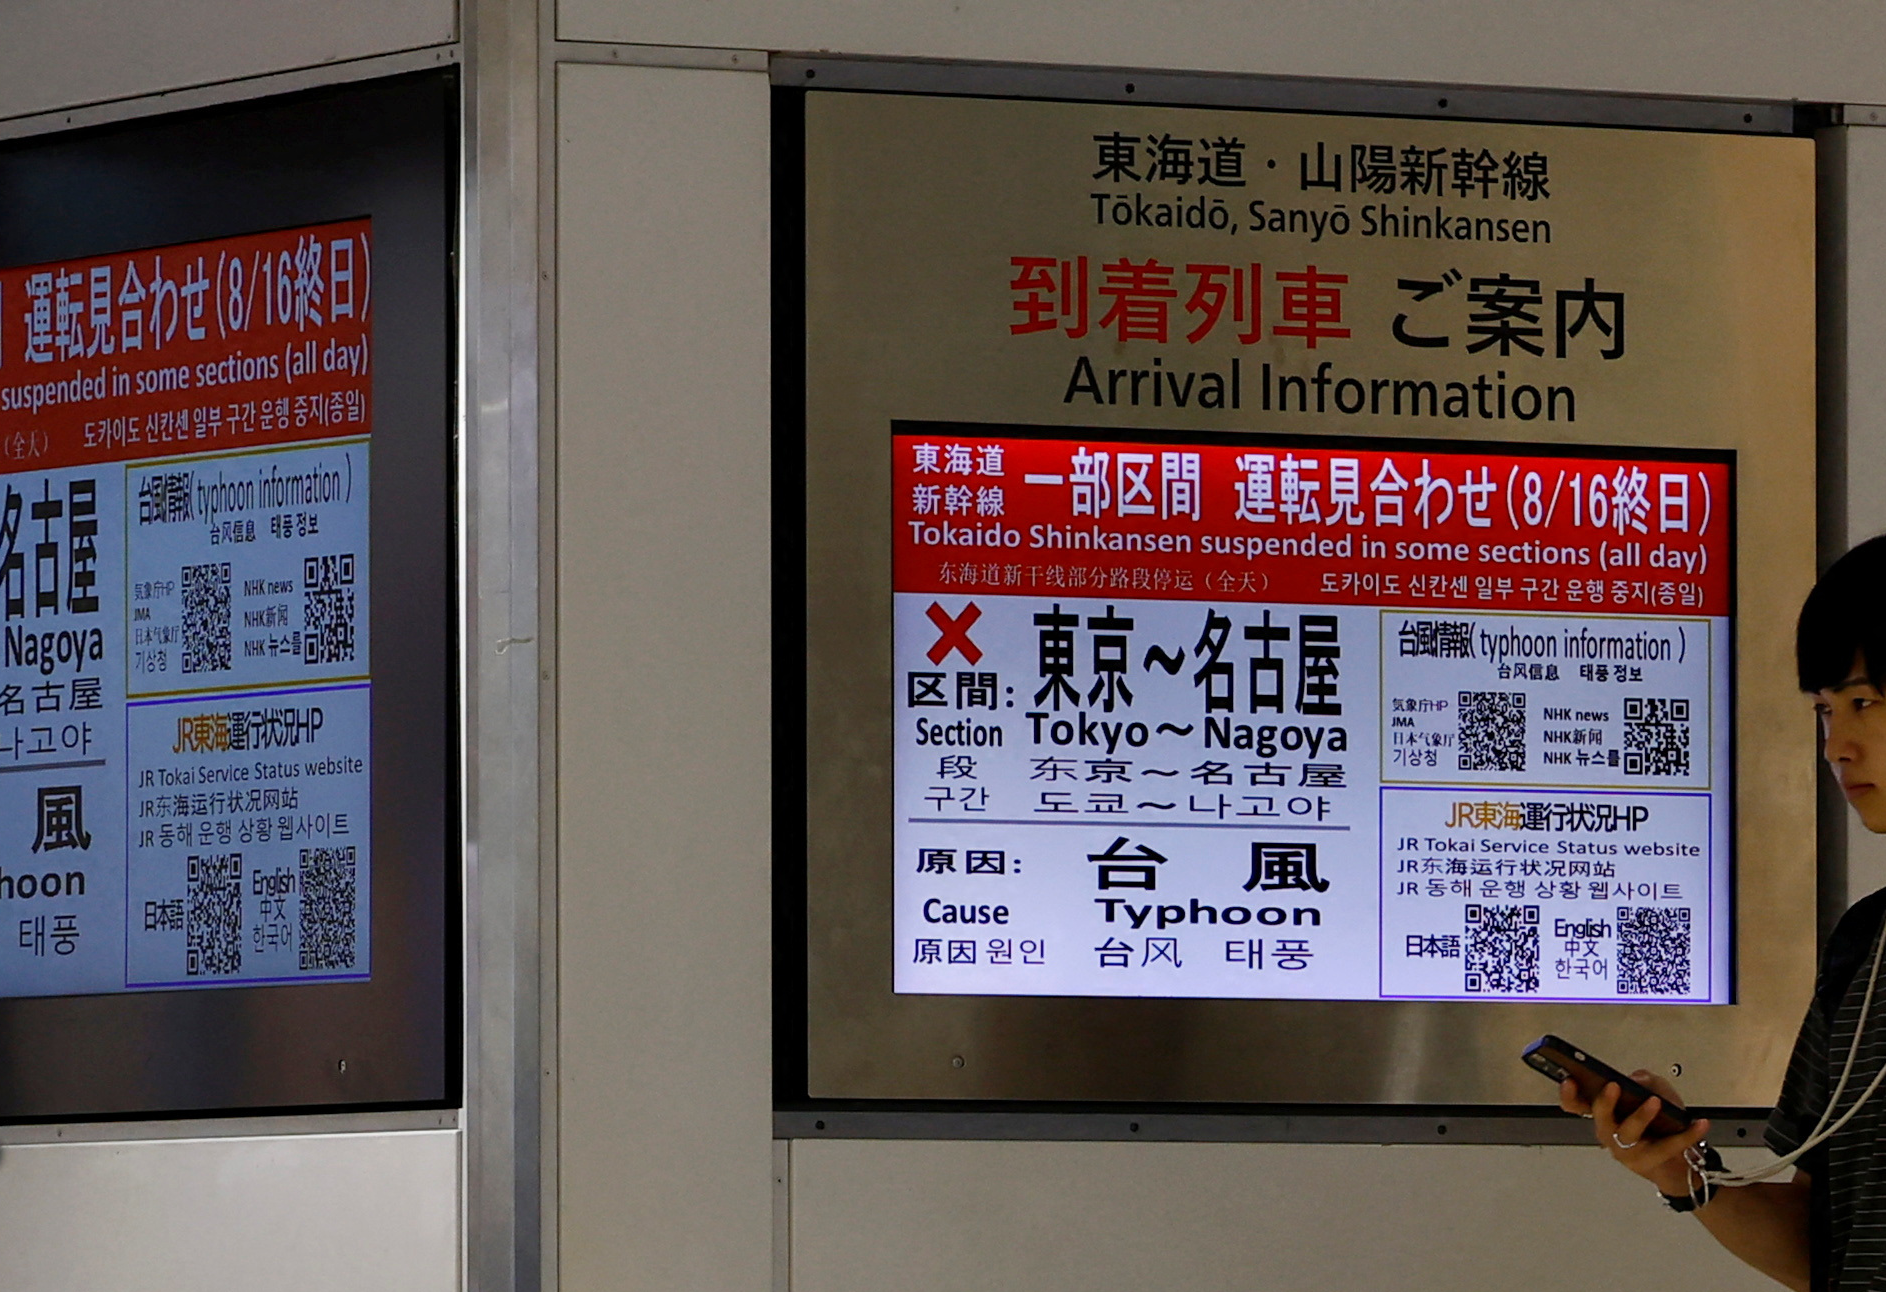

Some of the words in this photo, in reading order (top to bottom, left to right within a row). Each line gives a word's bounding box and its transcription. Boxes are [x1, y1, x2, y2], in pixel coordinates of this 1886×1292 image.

[1091, 131, 1551, 202] 東海道・山陽新幹線
[1249, 199, 1351, 243] Sanyō
[1360, 205, 1551, 245] Shinkansen
[1008, 254, 1352, 350] 到着列車
[1391, 267, 1626, 361] ご案内
[1, 366, 106, 415] suspended
[112, 365, 131, 397] in
[136, 365, 190, 395] some
[196, 350, 280, 388] sections
[285, 340, 317, 385] (all
[322, 332, 369, 377] day)
[1063, 355, 1241, 411] Arrival
[1261, 361, 1576, 423] Information
[83, 416, 141, 449] 도카이도
[145, 408, 189, 444] 신칸센
[193, 406, 222, 438] 일부
[226, 401, 257, 435] 구간
[261, 397, 290, 431] 운행
[912, 442, 1006, 477] 東海道
[197, 470, 255, 525] typhoon
[259, 462, 341, 510] information
[1024, 446, 1201, 522] 一部区間
[912, 483, 1006, 518] 新幹線
[271, 513, 294, 540] 태풍
[296, 511, 319, 538] 정보
[908, 520, 1021, 549] Tokaido
[1029, 523, 1192, 553] Shinkansen
[1200, 530, 1352, 561] suspended
[1361, 533, 1386, 559] in
[1394, 540, 1469, 563] some
[1478, 539, 1591, 566] sections
[1599, 541, 1640, 572] (all
[1649, 543, 1708, 575] day)
[244, 579, 266, 597] NHK
[267, 579, 294, 596] news
[1320, 571, 1402, 598] 도카이도
[1408, 574, 1468, 600] 신칸센
[1474, 576, 1514, 601] 일부
[1520, 578, 1559, 603] 구간
[1565, 578, 1605, 604] 운행
[134, 607, 151, 622] JMA
[244, 640, 266, 657] NHK
[1480, 625, 1557, 663] typhoon
[1564, 627, 1671, 661] information
[1497, 662, 1560, 681] 台风信息
[1580, 664, 1609, 682] 태풍
[1614, 664, 1643, 683] 정보
[1391, 716, 1415, 728] JMA
[1543, 707, 1571, 722] NHK
[1575, 709, 1609, 722] news
[915, 716, 1003, 748] Section
[139, 770, 154, 788] JR
[159, 767, 195, 787] Tokai
[198, 764, 249, 784] Service
[255, 761, 301, 781] Status
[305, 755, 363, 777] website
[936, 754, 978, 781] 段
[1393, 749, 1438, 767] 기상청
[1543, 751, 1572, 765] NHK
[924, 786, 990, 813] 구간
[139, 830, 154, 849] JR
[159, 822, 193, 848] 동해
[198, 819, 232, 846] 운행
[238, 815, 273, 844] 상황
[1397, 836, 1419, 852] JR
[1424, 837, 1475, 853] Tokai
[1481, 838, 1549, 854] Service
[1557, 840, 1618, 856] Status
[1624, 841, 1700, 858] website
[252, 866, 296, 897] English
[1397, 881, 1419, 897] JR
[1425, 879, 1472, 898] 동해
[1479, 880, 1526, 899] 운행
[1534, 880, 1581, 899] 상황
[144, 898, 185, 932] 日本語
[260, 896, 287, 923] 中文
[923, 898, 1010, 925] Cause
[1094, 898, 1321, 929] Typhoon
[19, 915, 80, 957] 태풍
[252, 922, 293, 953] 한국어
[1554, 918, 1612, 940] English
[913, 938, 978, 965] 原因
[985, 937, 1045, 966] 원인
[1094, 937, 1183, 968] 台风
[1225, 937, 1315, 970] 태풍
[1406, 934, 1461, 959] 日本語
[1564, 938, 1600, 958] 中文
[1554, 959, 1608, 981] 한국어
